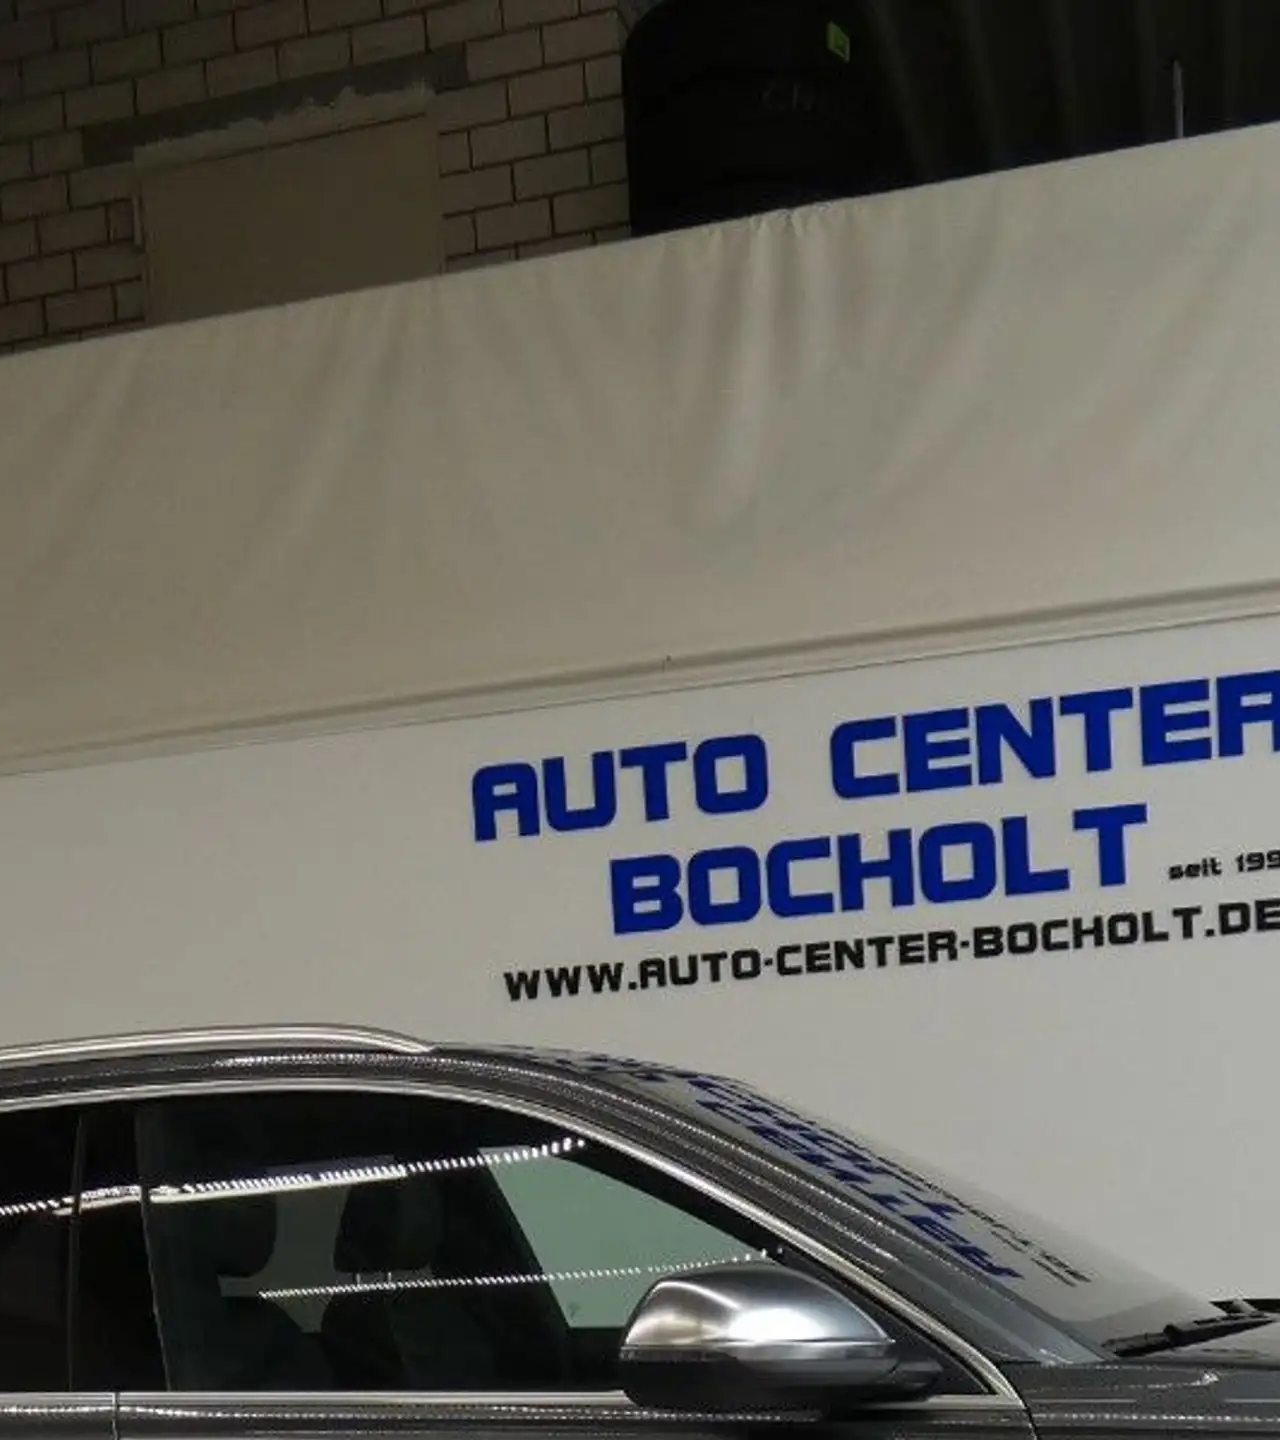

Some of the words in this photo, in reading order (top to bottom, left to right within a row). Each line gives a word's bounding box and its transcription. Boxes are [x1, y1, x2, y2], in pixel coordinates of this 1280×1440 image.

[472, 734, 769, 842] AUTO
[609, 803, 1148, 935] BOCHOLT
[1167, 856, 1223, 881] seit
